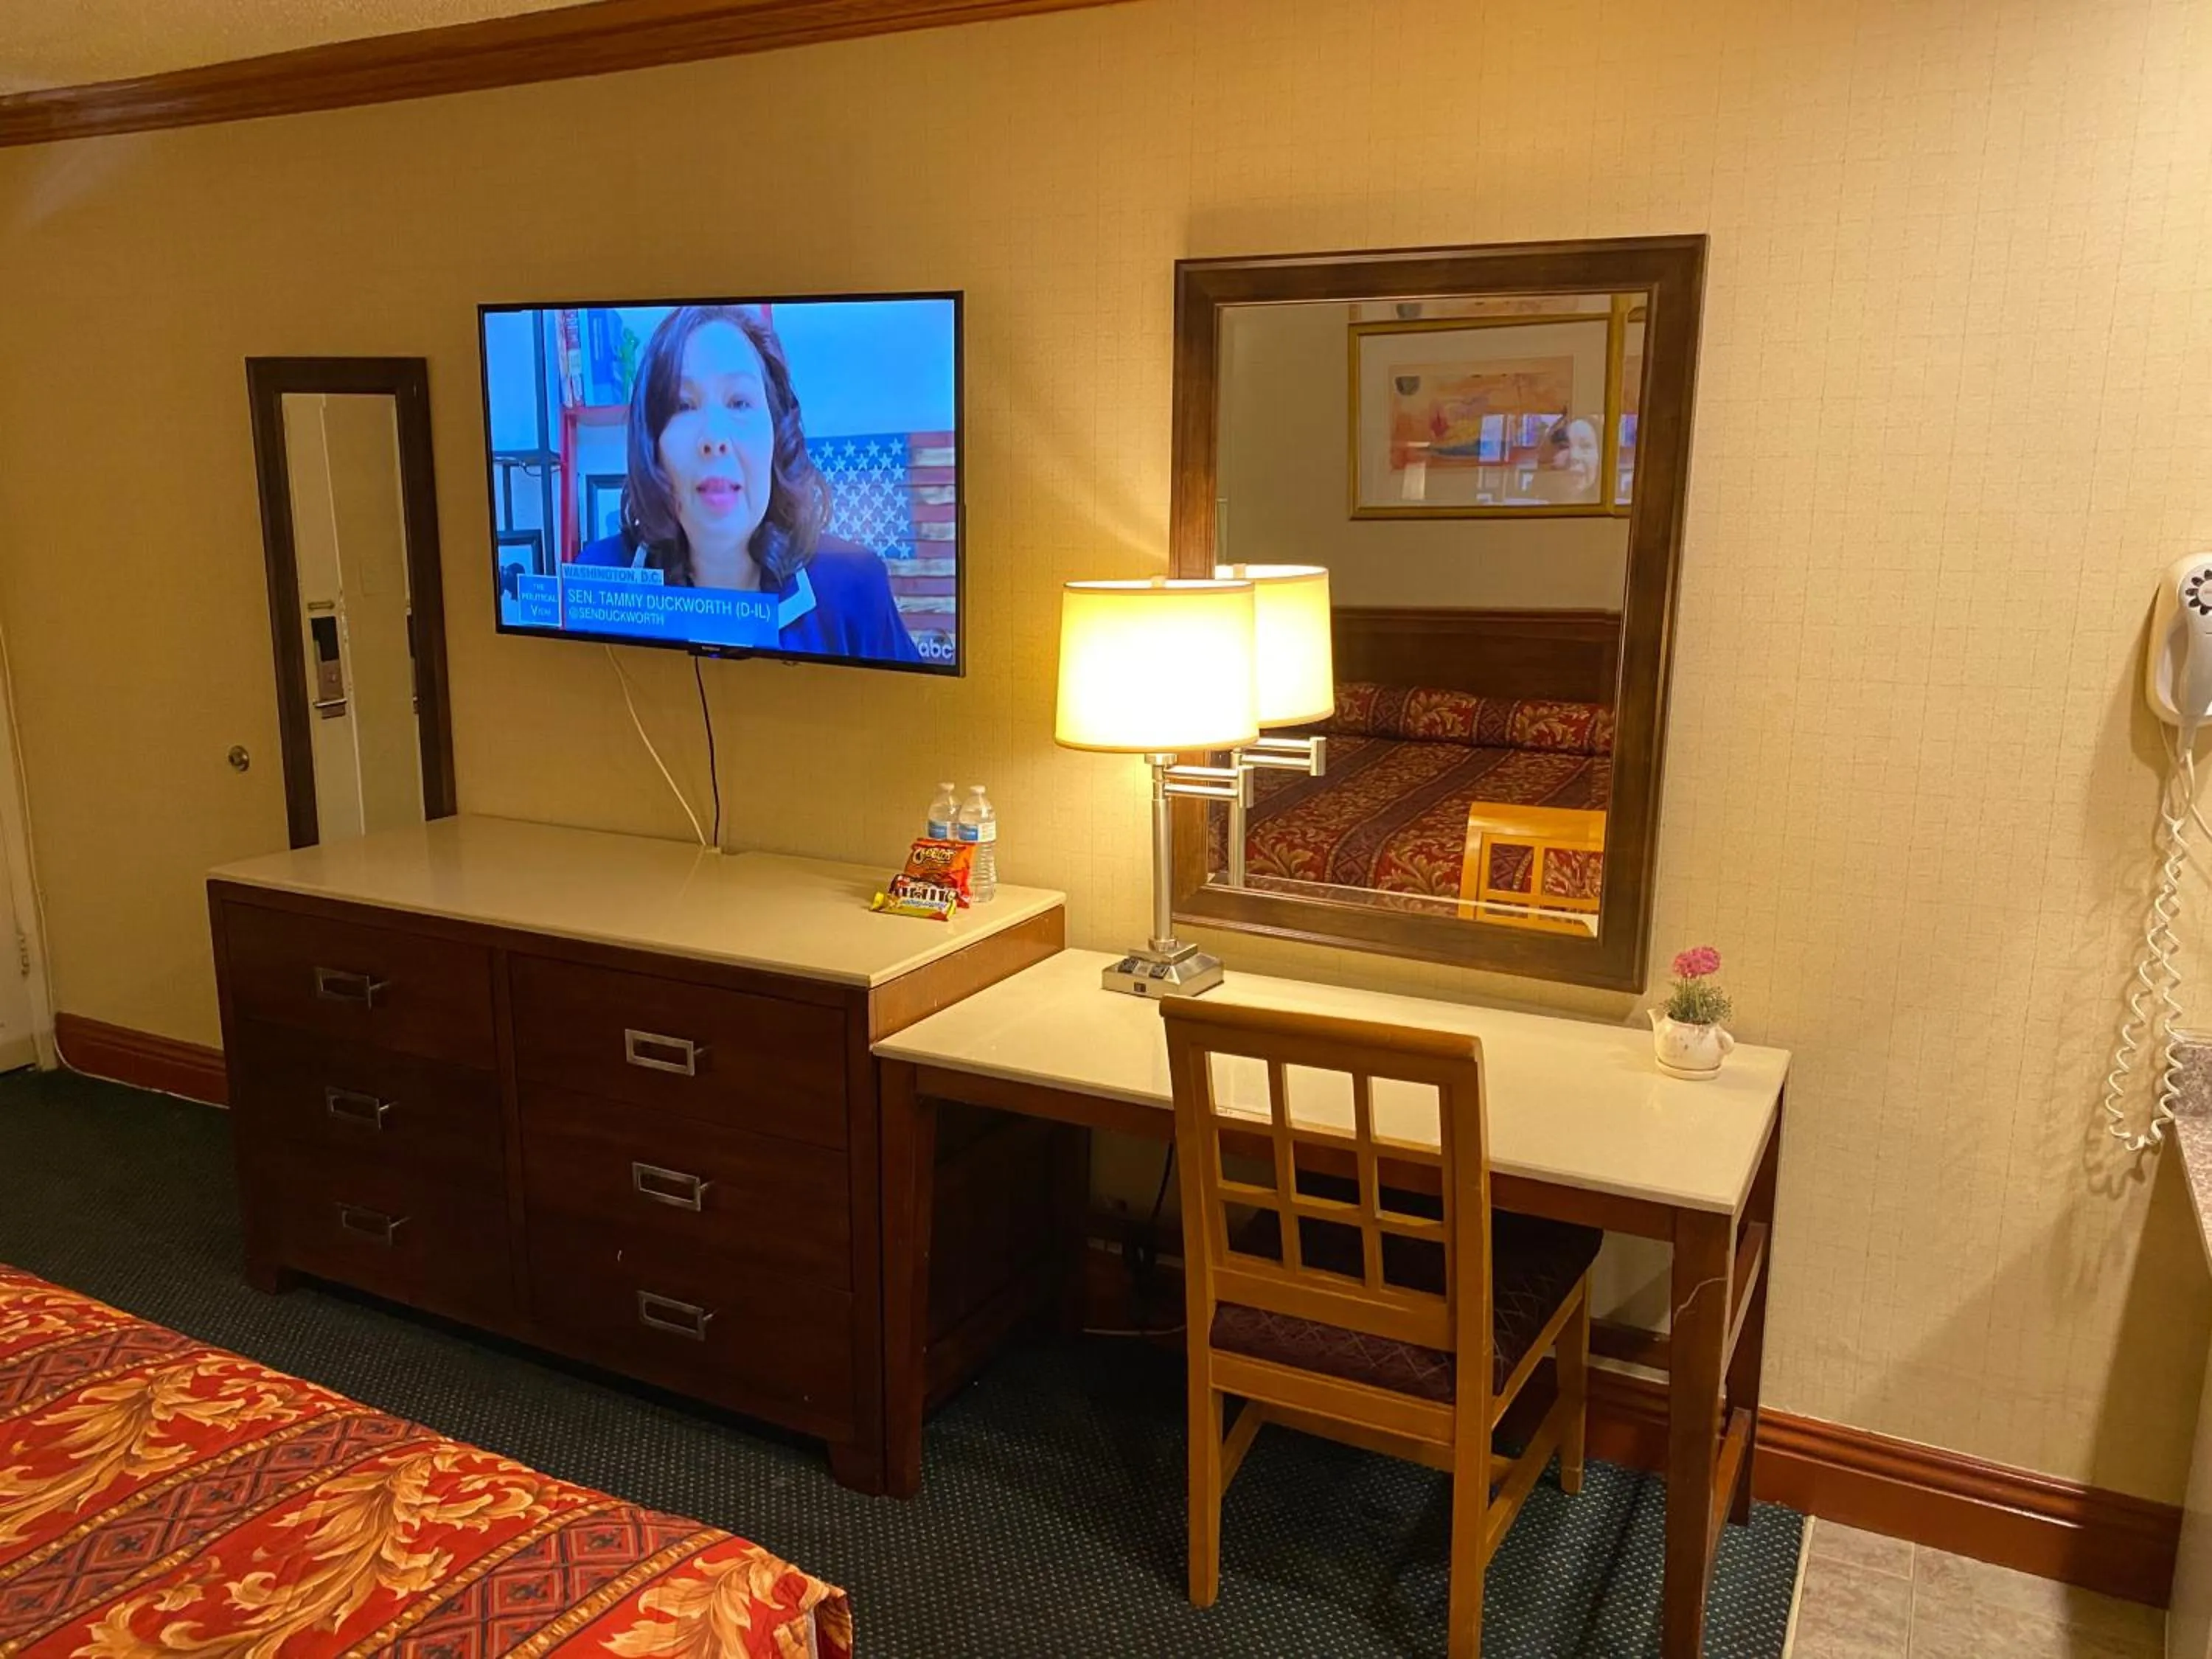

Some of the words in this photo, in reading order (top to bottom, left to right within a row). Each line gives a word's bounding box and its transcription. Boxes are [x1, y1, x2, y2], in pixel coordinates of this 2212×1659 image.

[563, 565, 637, 583] WASHINGTON,
[640, 569, 662, 583] D.C.
[568, 588, 596, 605] SEN.
[599, 591, 644, 608] TAMMY
[647, 594, 732, 615] DUCKWORTH
[736, 601, 771, 622] (D-IL)
[568, 606, 664, 625] @SENDUCKWORTH
[918, 637, 953, 658] abc
